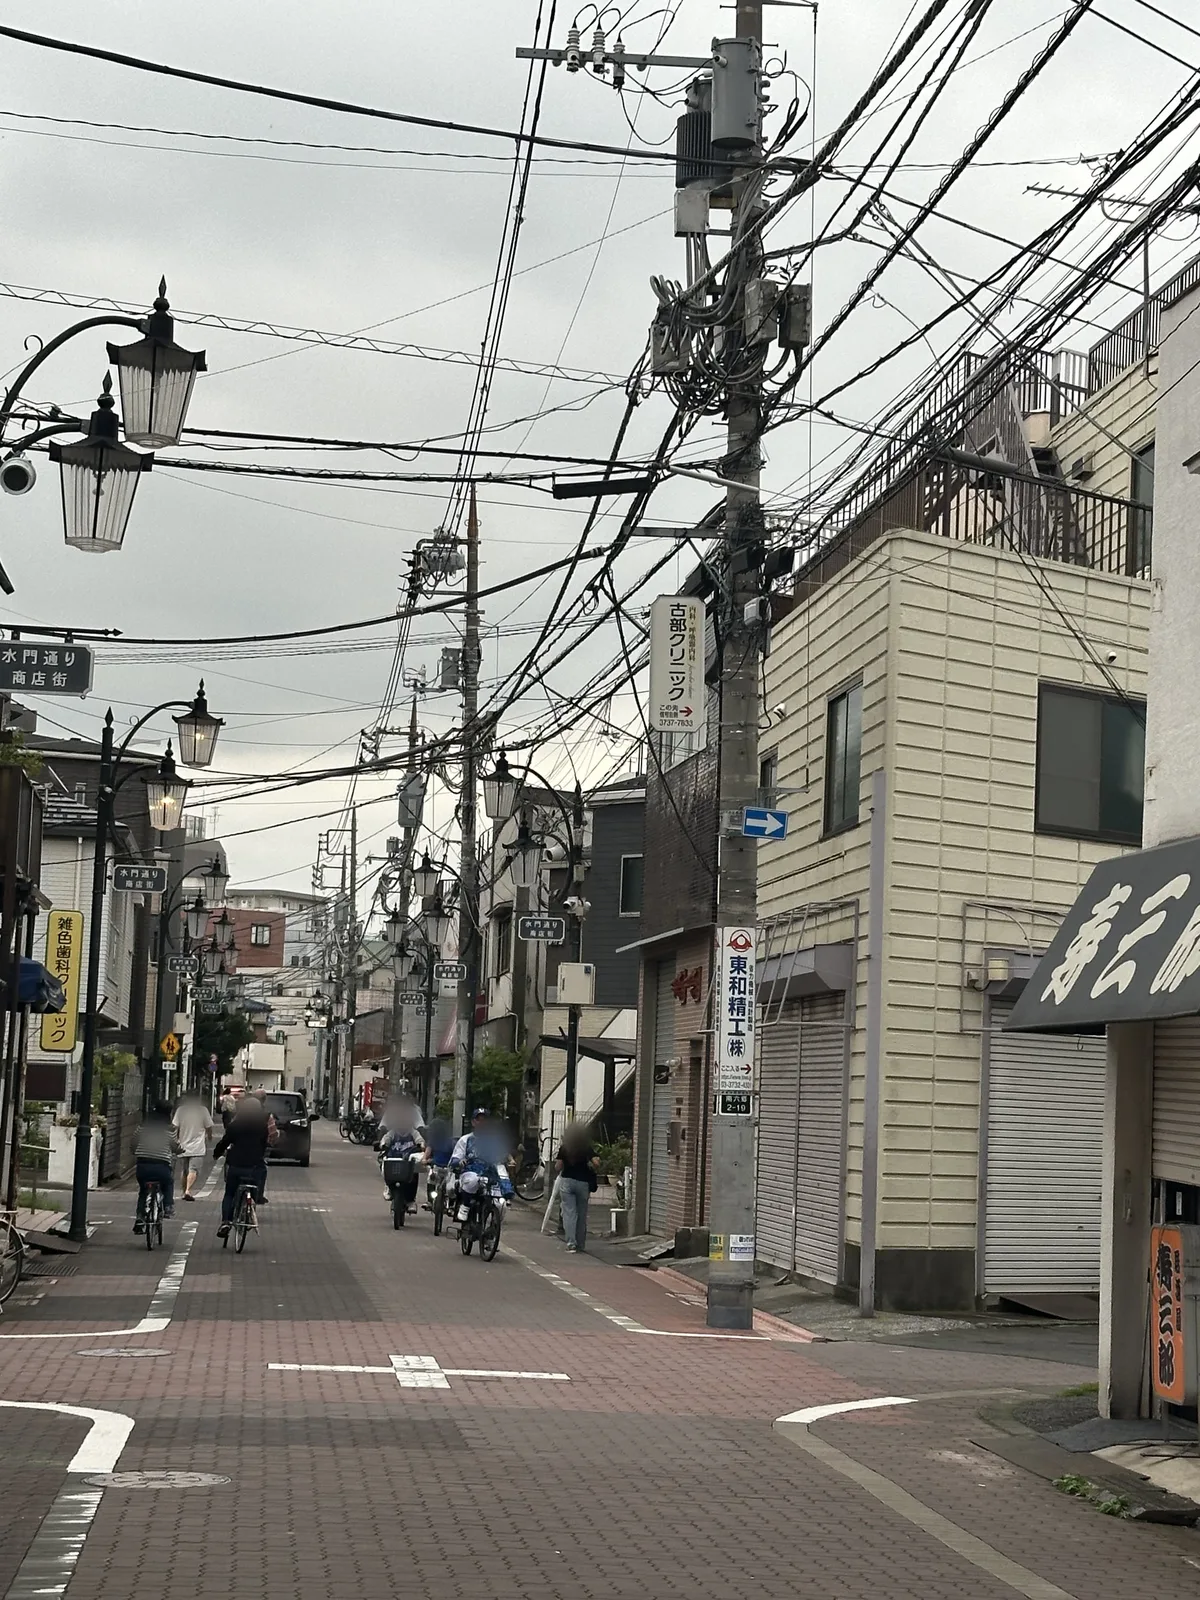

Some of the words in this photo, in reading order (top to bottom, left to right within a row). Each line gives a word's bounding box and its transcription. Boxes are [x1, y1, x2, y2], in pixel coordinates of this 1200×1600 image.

[1, 648, 75, 666] 水門通り
[668, 603, 687, 701] 古部クリニック
[12, 670, 67, 687] 商店街
[120, 869, 158, 878] 水門通り
[125, 880, 154, 888] 商店街
[51, 917, 73, 1042] 雑色歯科クック
[726, 1104, 746, 1112] 2-19
